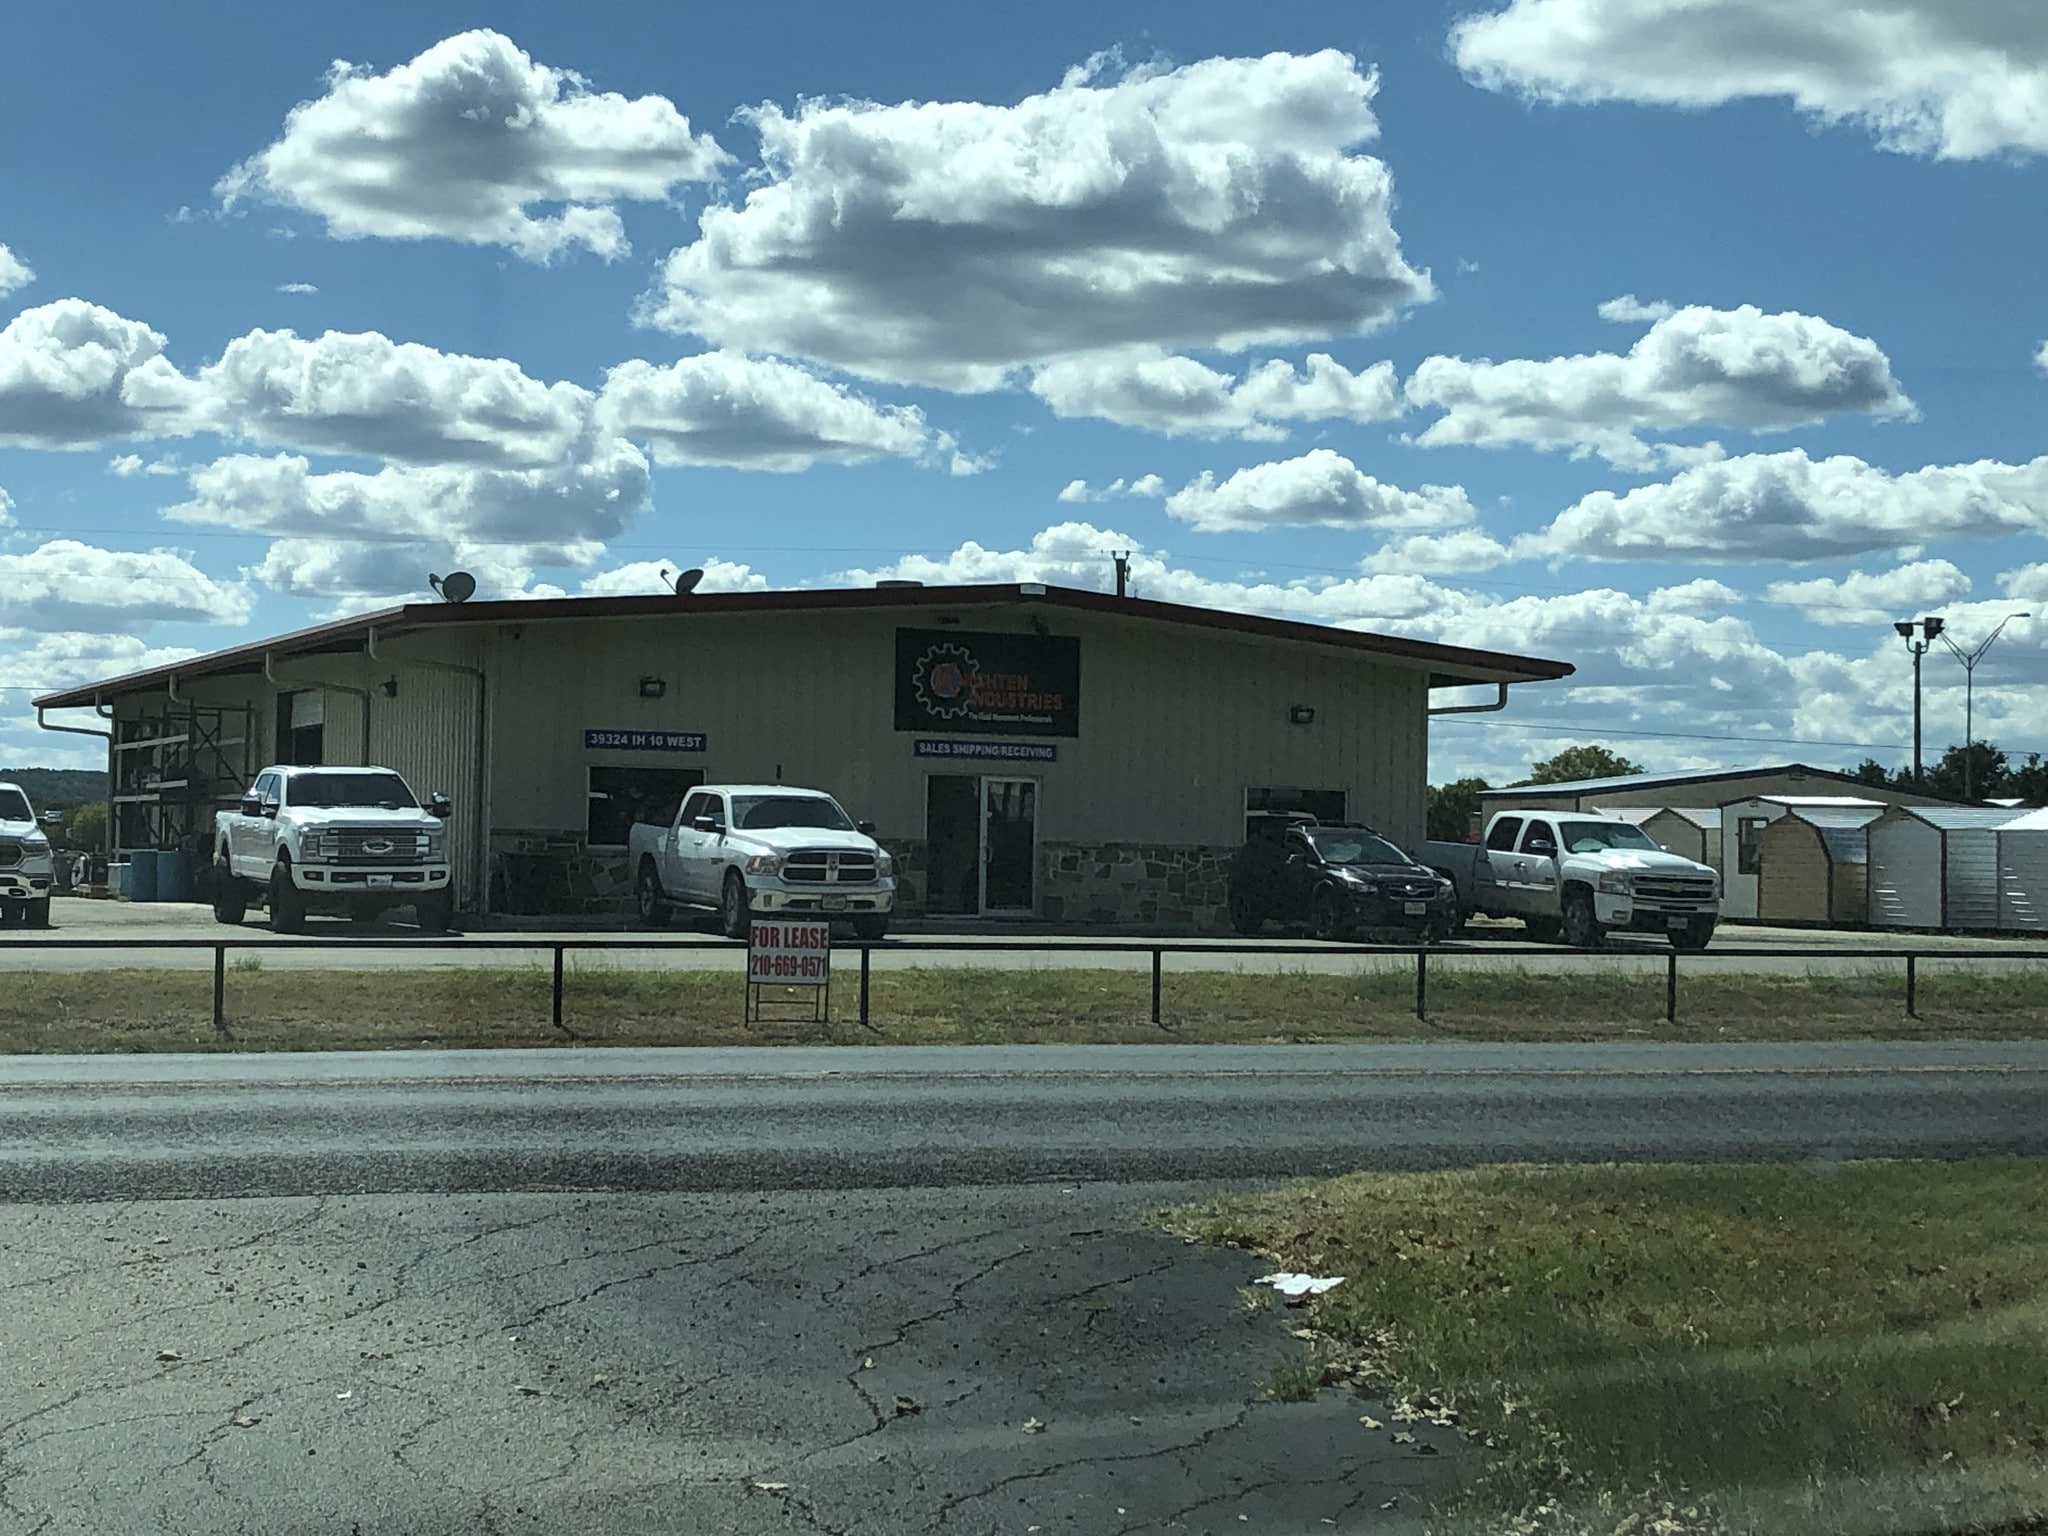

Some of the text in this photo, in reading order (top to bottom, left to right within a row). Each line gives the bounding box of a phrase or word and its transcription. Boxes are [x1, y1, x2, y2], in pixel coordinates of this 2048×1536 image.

[969, 691, 1063, 711] INDUSTRIES
[591, 734, 702, 748] 39324 IH 10 WEST
[919, 742, 1053, 758] SALES SHIPPING RECEIVING
[751, 926, 828, 949] FOR LEASE
[752, 955, 826, 977] 210-669-0571
